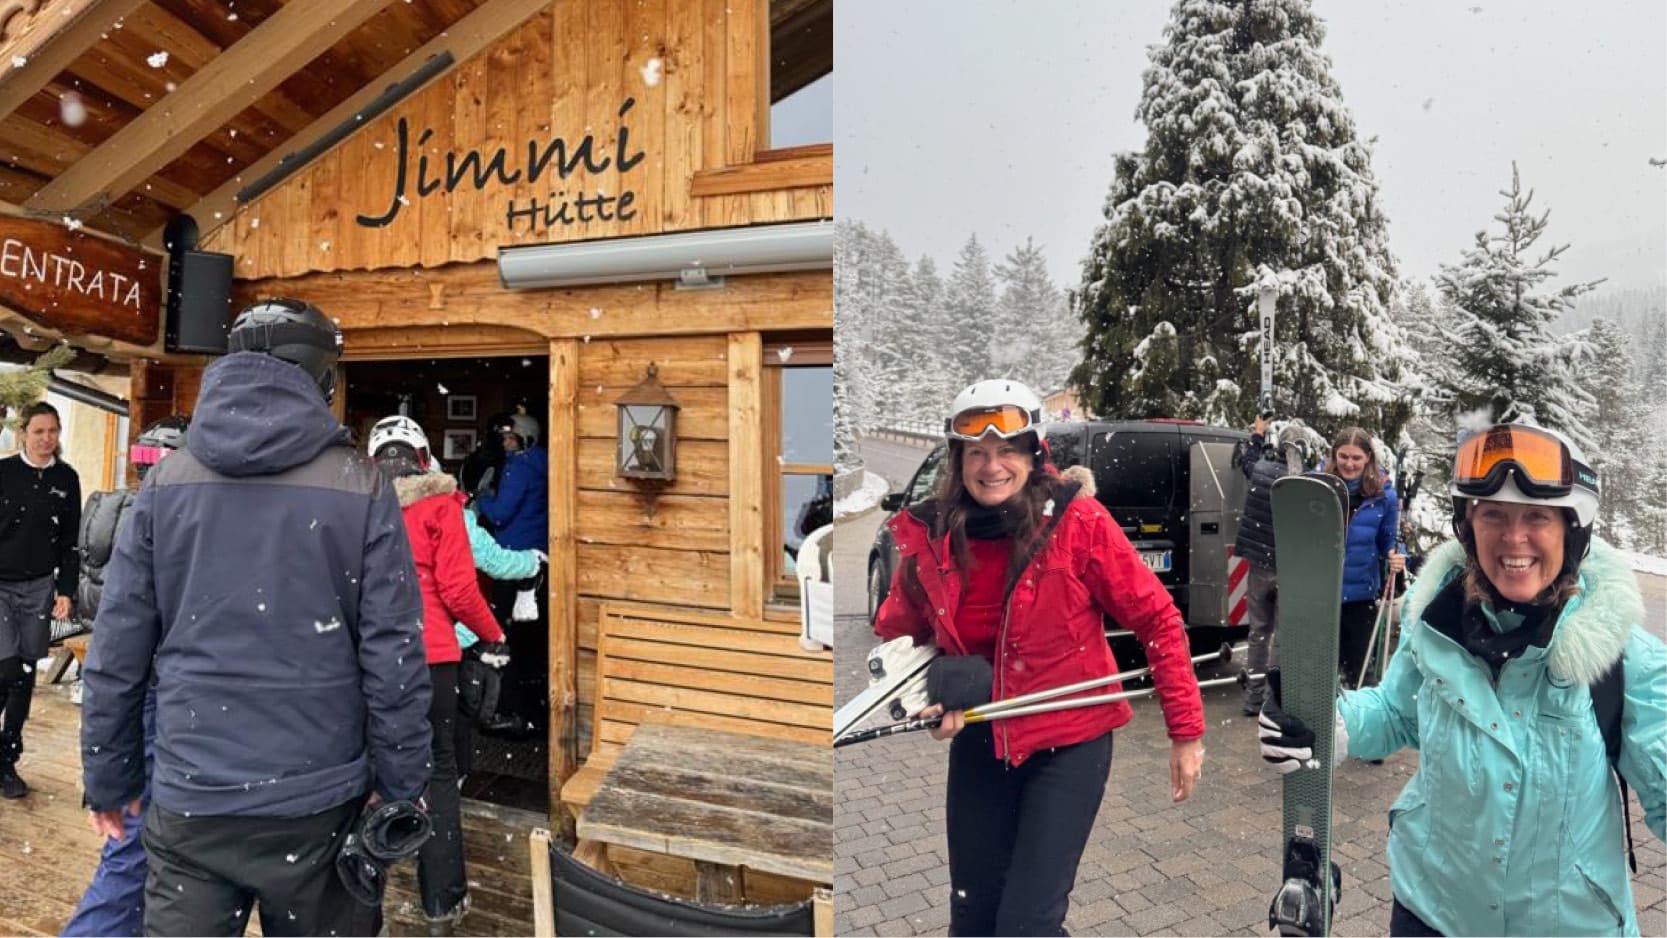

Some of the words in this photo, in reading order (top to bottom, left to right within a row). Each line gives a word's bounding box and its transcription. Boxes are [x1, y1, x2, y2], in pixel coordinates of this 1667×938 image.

[356, 97, 645, 228] Jimmi
[506, 191, 637, 231] Hütte
[0, 238, 141, 309] ENTRATA
[1263, 316, 1271, 364] HEAD
